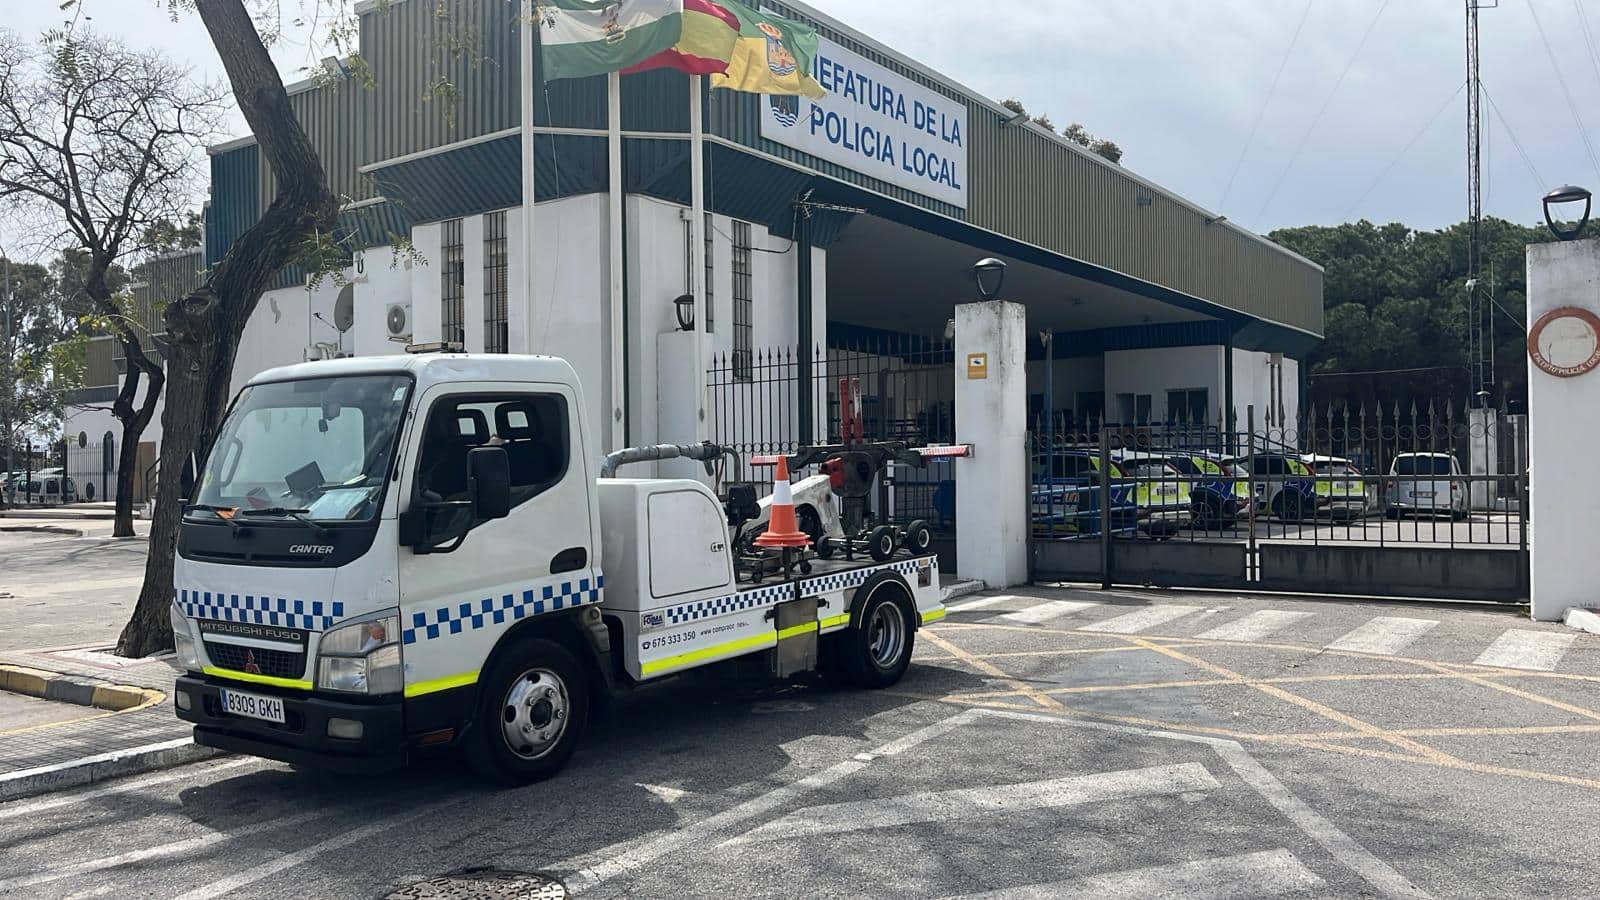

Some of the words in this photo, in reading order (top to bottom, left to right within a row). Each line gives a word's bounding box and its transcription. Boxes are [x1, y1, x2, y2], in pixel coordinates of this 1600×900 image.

[914, 100, 937, 137] DE
[942, 113, 962, 147] LA
[810, 103, 895, 166] POLICIA
[903, 142, 961, 190] LOCAL
[289, 544, 335, 554] CANTER
[200, 622, 263, 636] MITSUBISHI
[266, 629, 301, 640] FUSO
[652, 637, 666, 648] 675
[668, 634, 681, 645] 333
[683, 630, 696, 642] 350
[229, 693, 255, 714] 8309
[259, 698, 282, 720] GKH
